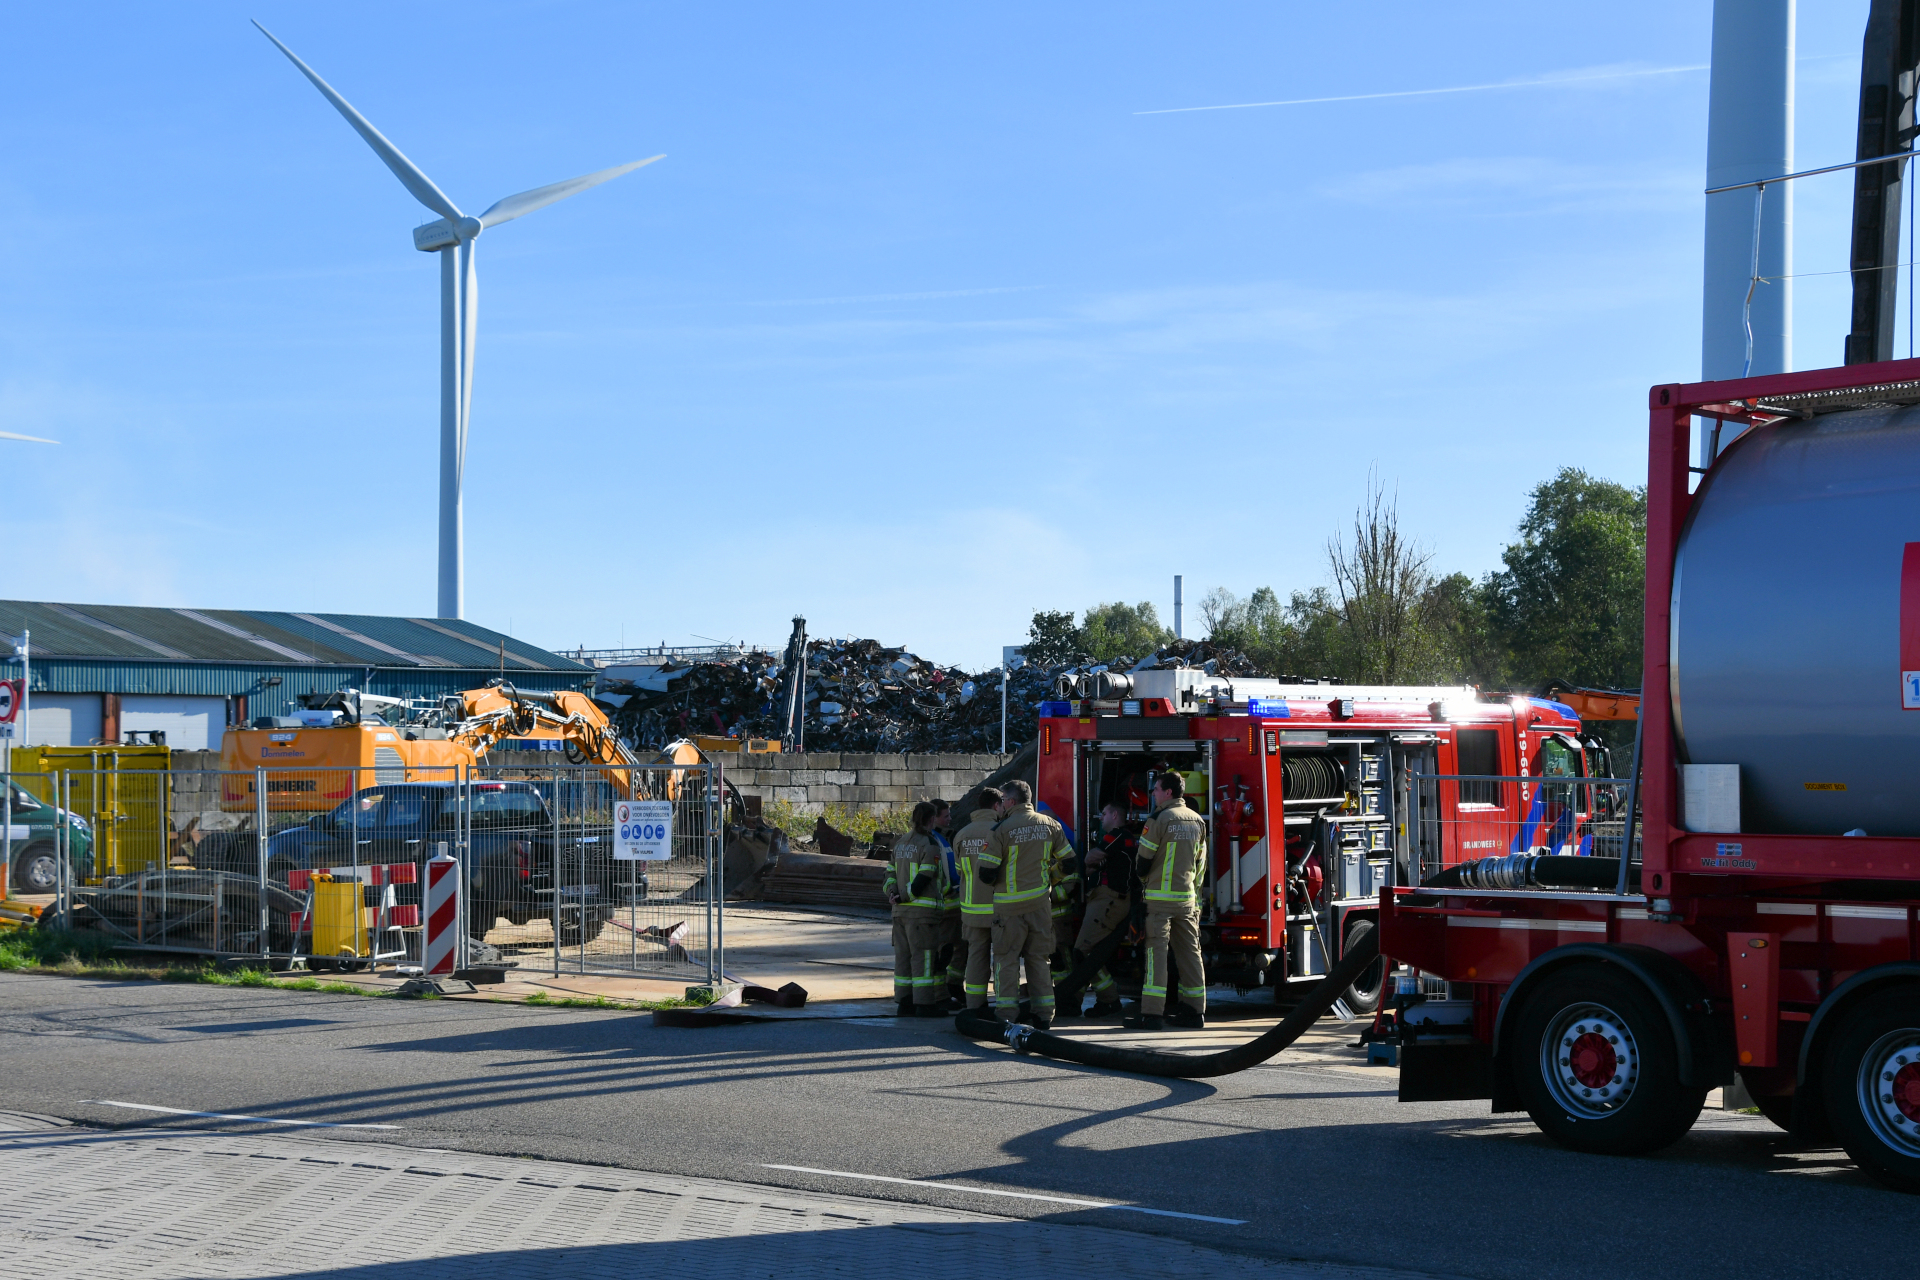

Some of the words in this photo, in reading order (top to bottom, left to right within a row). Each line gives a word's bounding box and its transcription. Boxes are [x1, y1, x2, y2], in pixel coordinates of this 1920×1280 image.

[6, 728, 12, 738] m
[271, 733, 293, 741] 924
[377, 733, 391, 741] 924
[261, 746, 305, 758] Dommelen
[248, 779, 316, 793] LBHERR
[1009, 824, 1049, 839] BRANDWEE
[1014, 832, 1047, 844] ZEELAND
[1463, 840, 1496, 849] BRANDWEER
[1701, 858, 1730, 868] Welfit
[1731, 859, 1757, 871] Oddy
